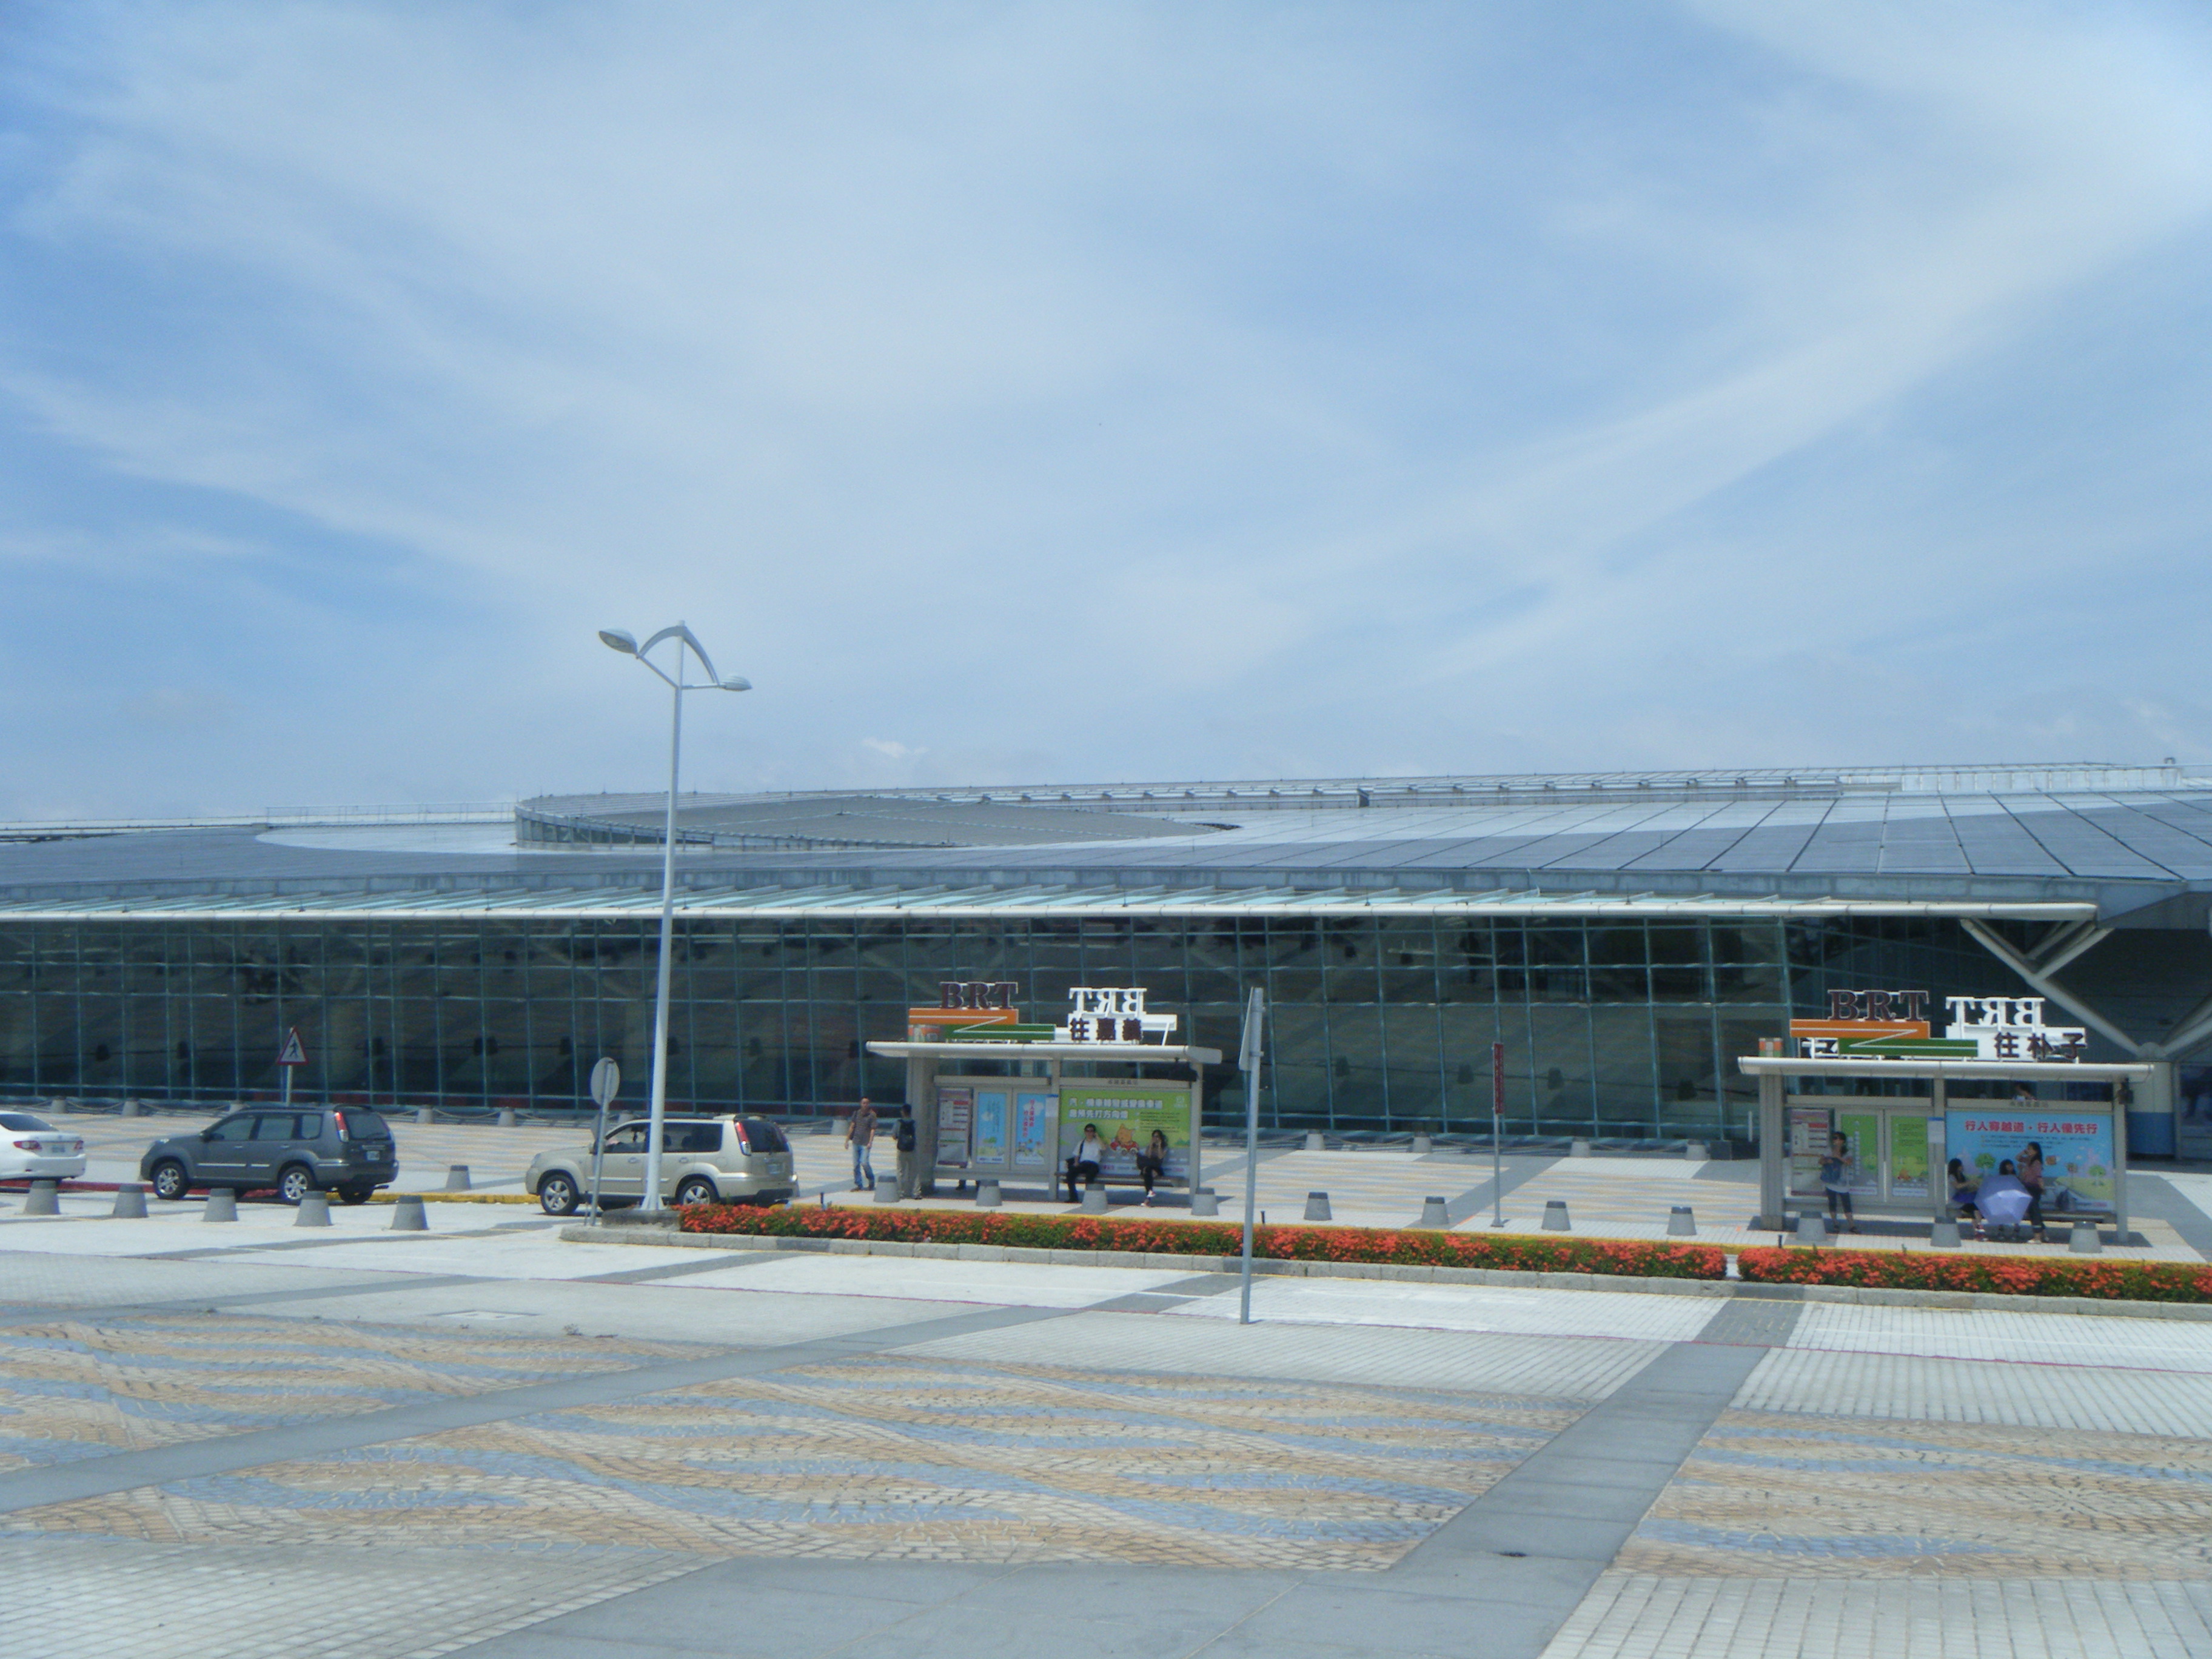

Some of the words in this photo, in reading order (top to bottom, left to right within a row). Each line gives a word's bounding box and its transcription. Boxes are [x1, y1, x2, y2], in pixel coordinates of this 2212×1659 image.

[940, 982, 1019, 1009] BRT
[1828, 990, 1930, 1022] BRT
[1994, 1032, 2086, 1059] 往朴子
